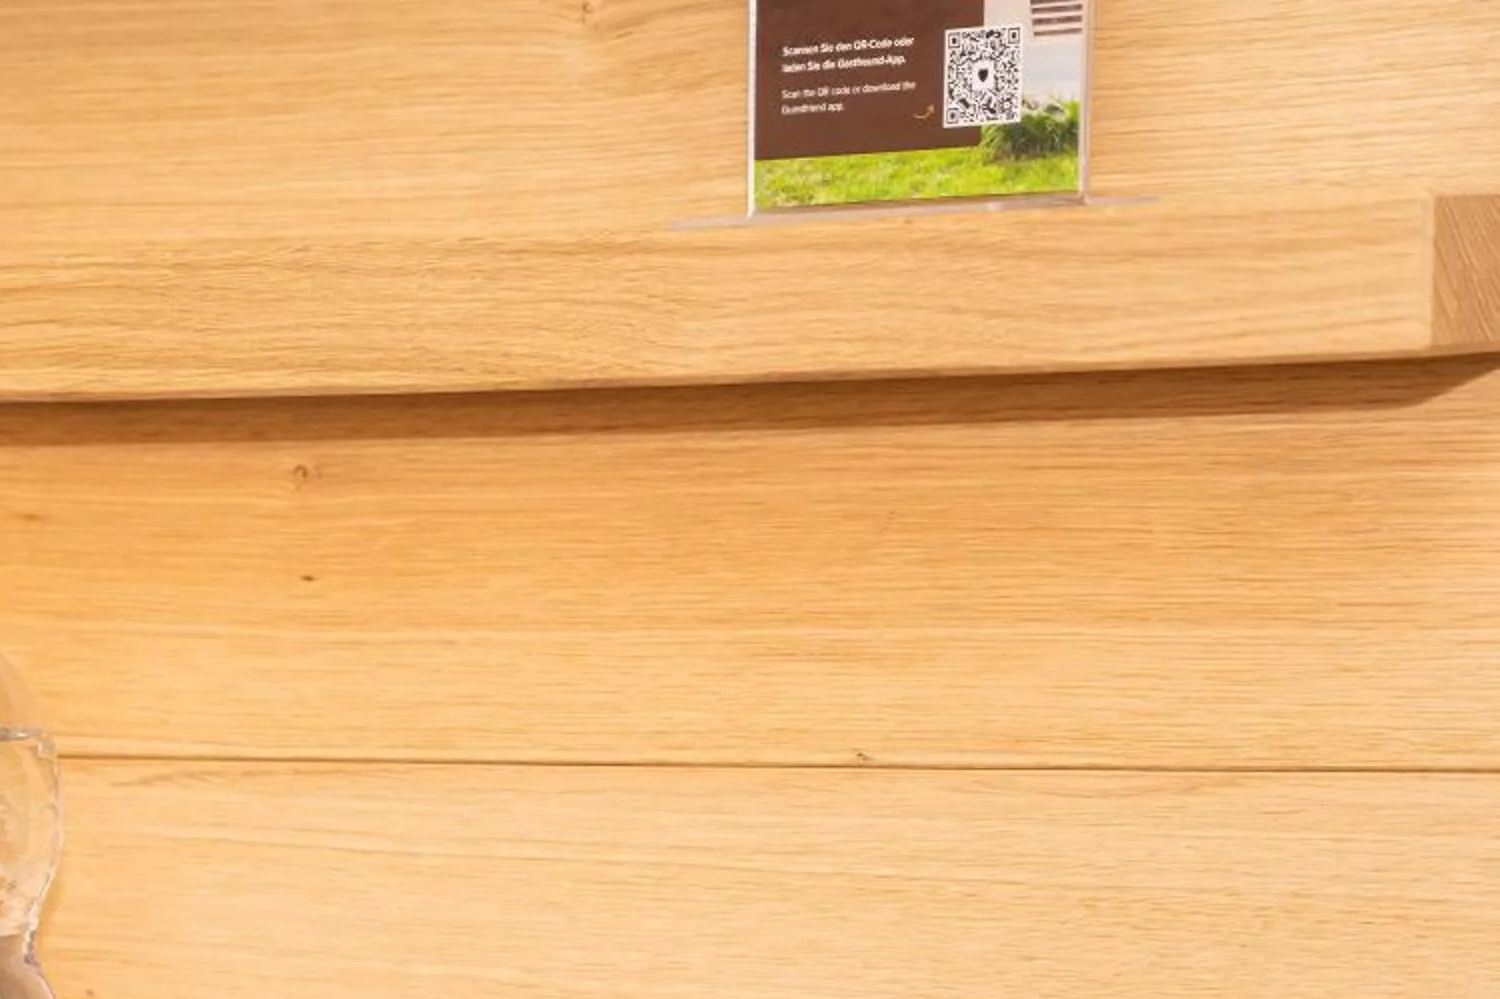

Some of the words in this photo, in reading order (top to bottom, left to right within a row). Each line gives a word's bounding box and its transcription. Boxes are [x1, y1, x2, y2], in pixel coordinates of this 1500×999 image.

[781, 46, 819, 57] Scannen
[820, 43, 834, 53] Sie
[835, 42, 853, 53] den
[853, 39, 892, 51] QR-Code
[894, 36, 915, 48] oder
[781, 63, 806, 73] laden
[807, 60, 821, 72] Sie
[822, 59, 837, 70] die
[781, 88, 800, 99] Scan
[802, 87, 816, 98] the
[817, 86, 830, 97] QR
[831, 85, 851, 96] code
[861, 82, 901, 94] download
